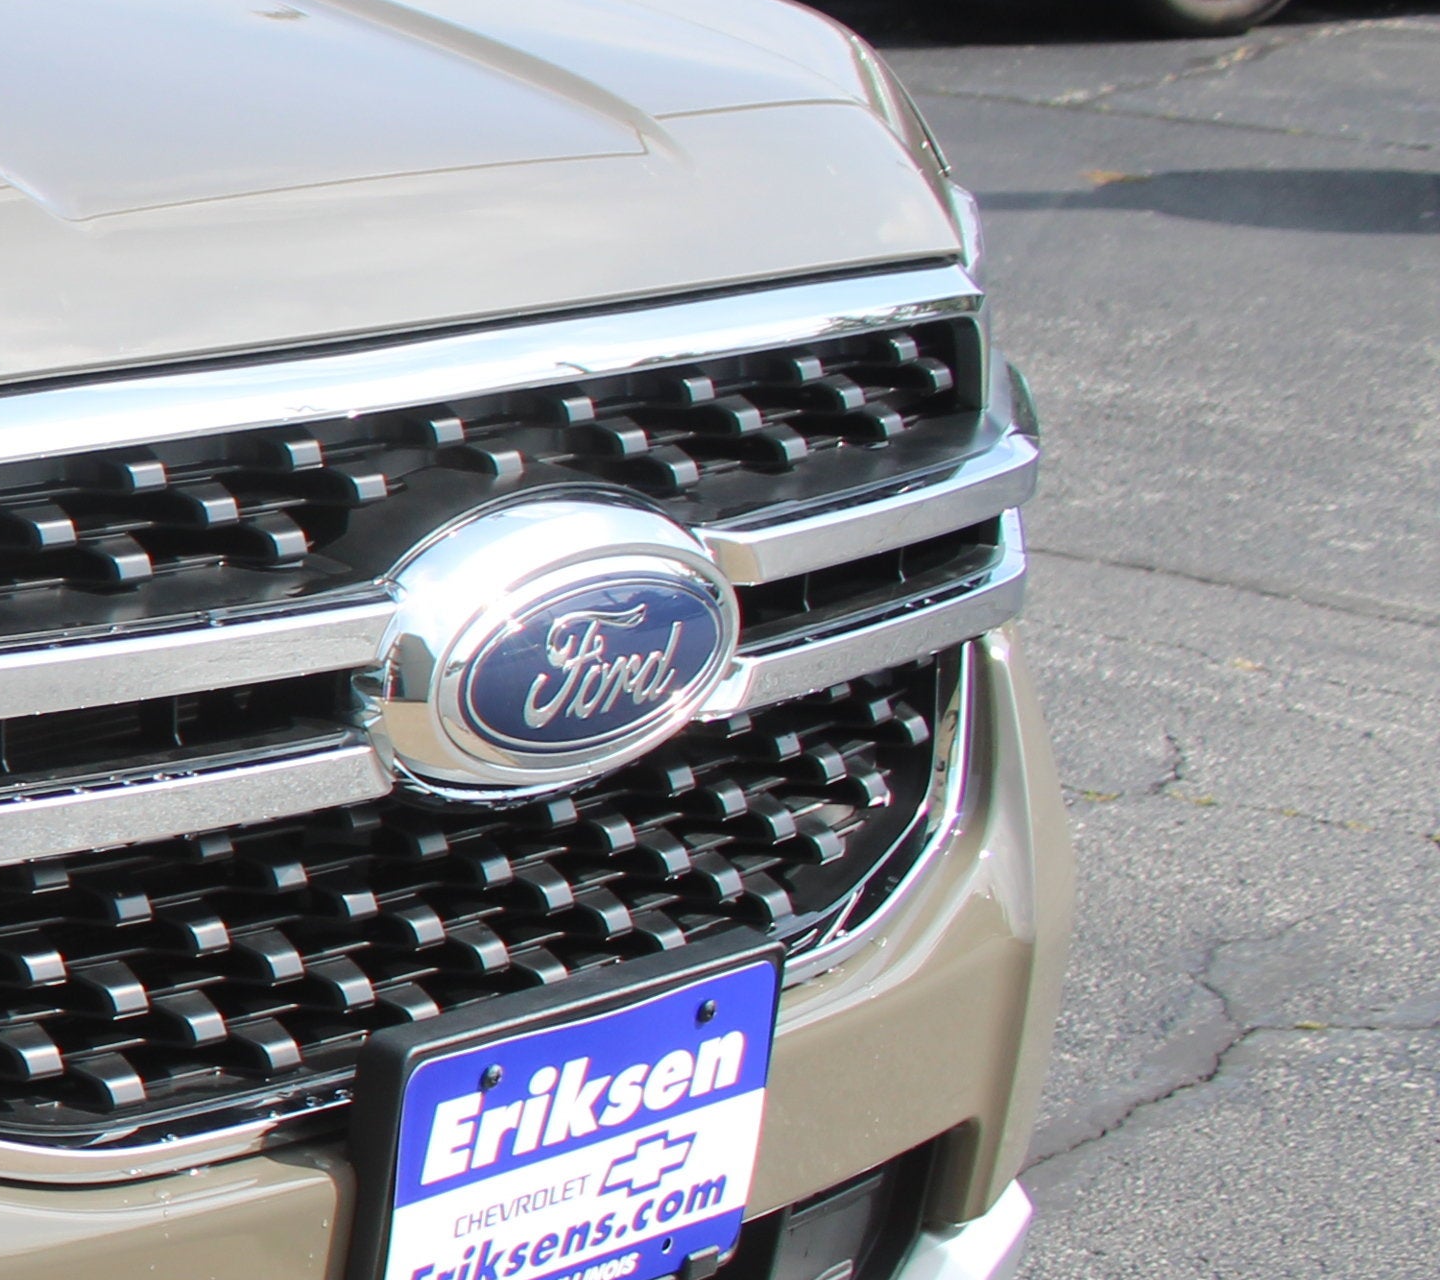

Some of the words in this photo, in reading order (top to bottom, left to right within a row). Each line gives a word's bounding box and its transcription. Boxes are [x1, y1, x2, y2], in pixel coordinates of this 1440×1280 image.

[522, 603, 683, 730] Ford
[420, 1030, 745, 1186] Eriksen
[453, 1173, 592, 1239] CHEVROLET
